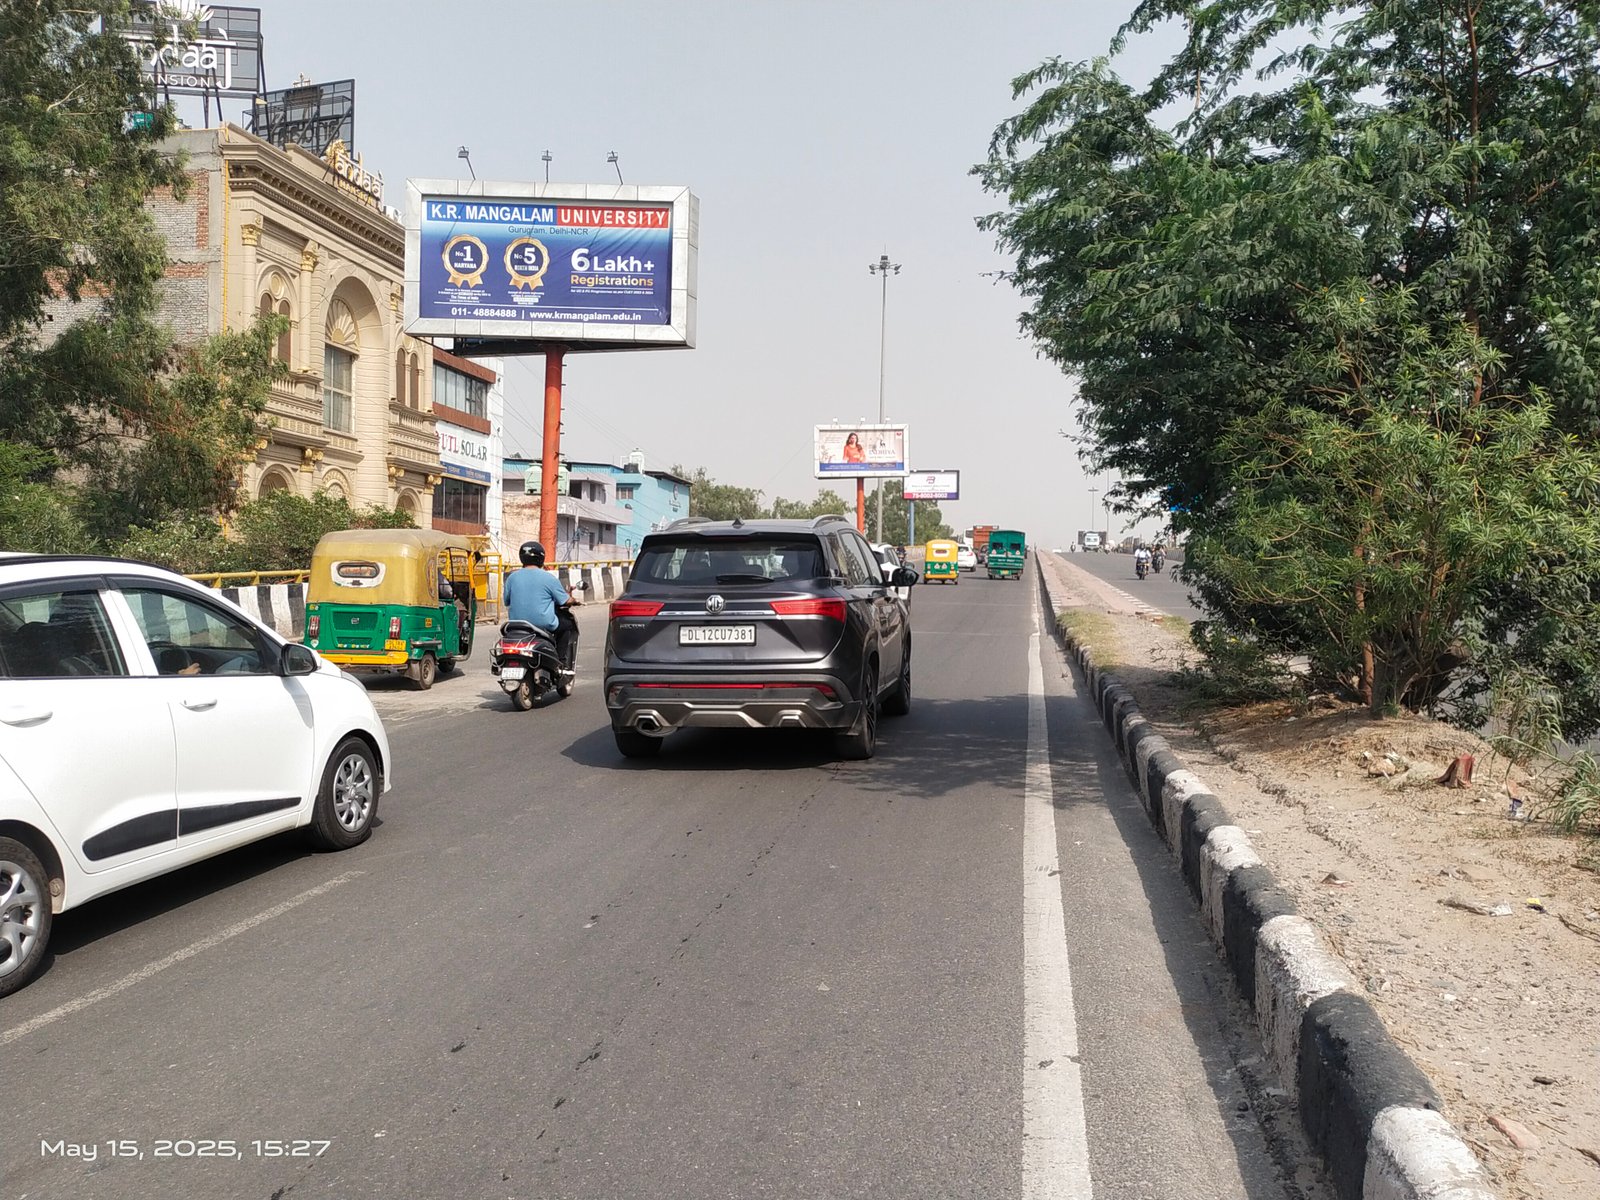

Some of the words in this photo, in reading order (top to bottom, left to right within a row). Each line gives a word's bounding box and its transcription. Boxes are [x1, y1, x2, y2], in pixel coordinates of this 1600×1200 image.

[431, 203, 461, 219] K.R.
[465, 205, 554, 223] MANGALAM
[560, 208, 666, 225] UNIVERSITY
[549, 227, 589, 236] Delhi-NCR
[571, 247, 590, 272] 6
[593, 255, 655, 272] Lakh+
[570, 274, 654, 287] Registrations
[529, 310, 642, 322] www.krmangalam.edu.in
[441, 434, 459, 454] UTL
[461, 439, 487, 461] SOLAR
[706, 596, 725, 613] MG
[687, 628, 753, 641] DL12CU7381
